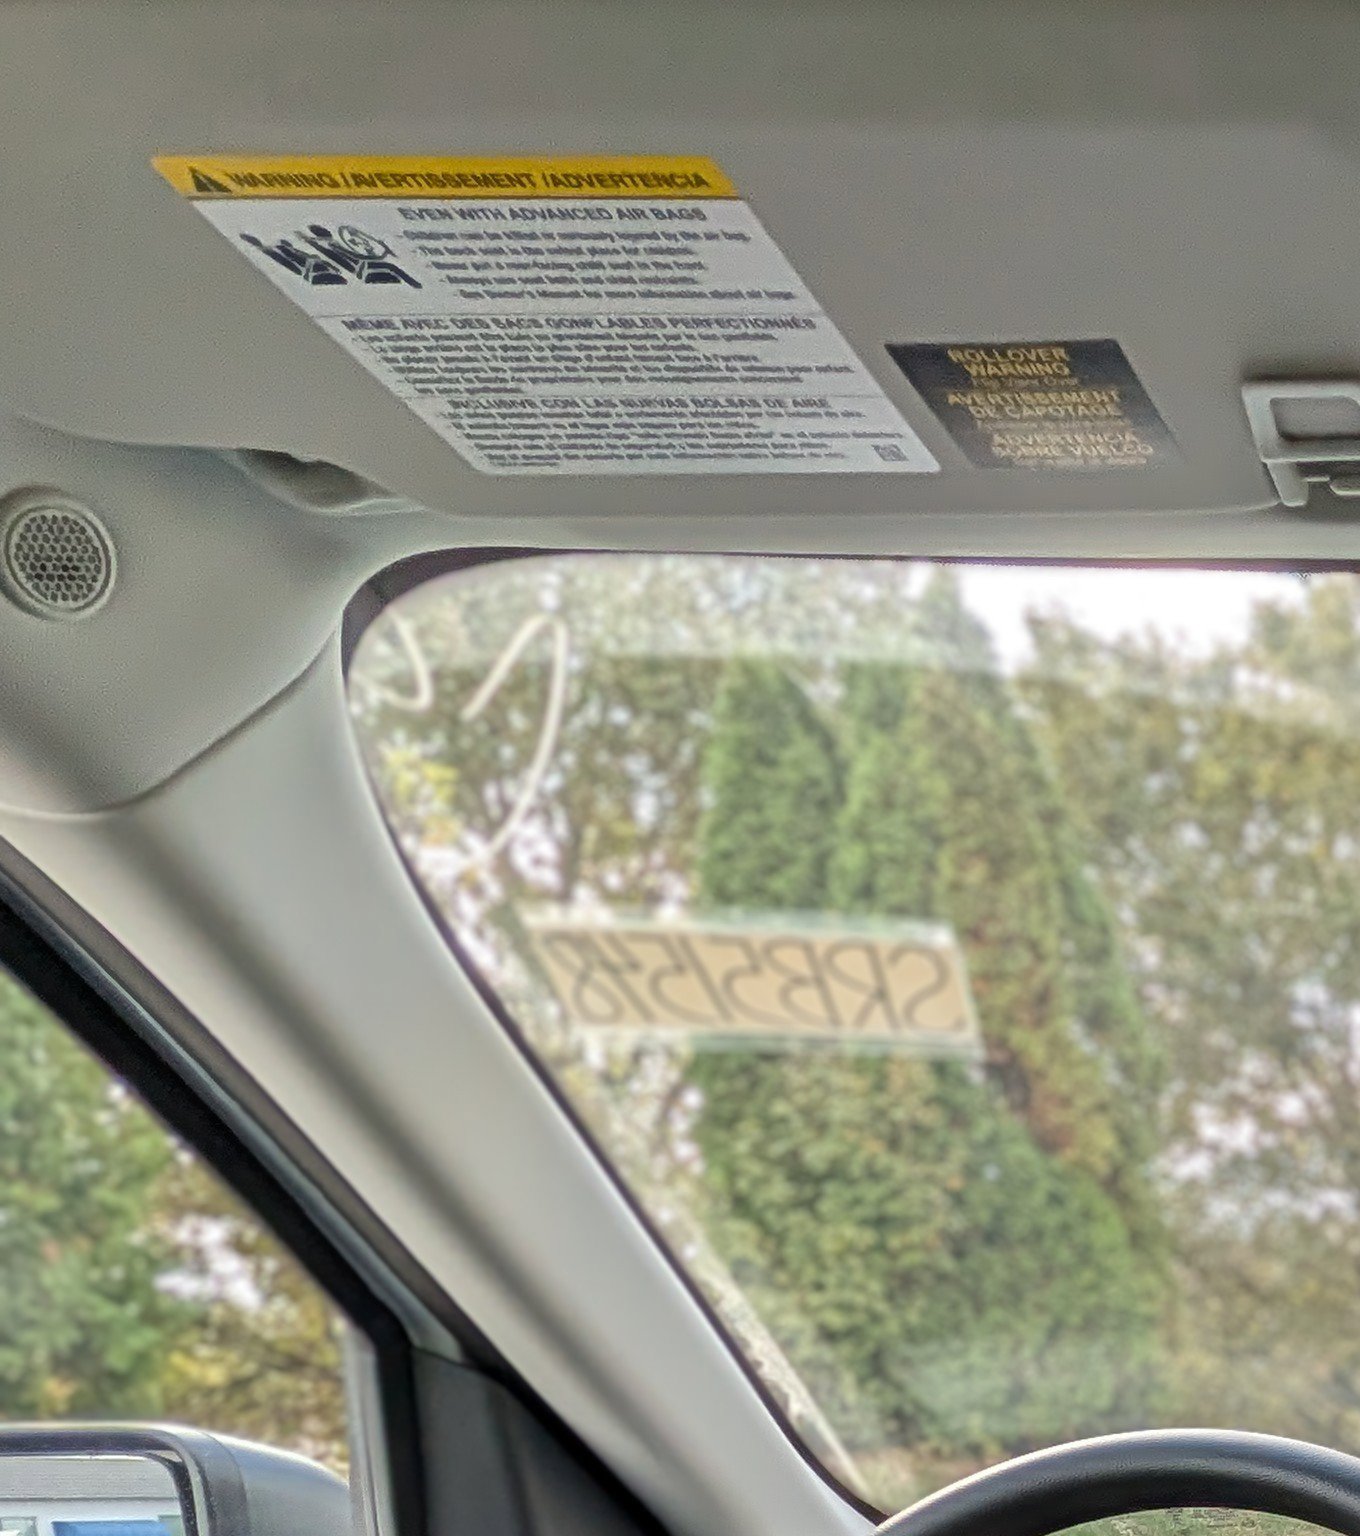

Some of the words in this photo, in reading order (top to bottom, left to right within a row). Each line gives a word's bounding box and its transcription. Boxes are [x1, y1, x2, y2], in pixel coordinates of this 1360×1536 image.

[226, 172, 340, 189] WARNING
[397, 207, 454, 221] EVEN
[455, 207, 507, 221] WITH
[509, 208, 614, 222] ADVANCED
[617, 208, 650, 221] AIR
[948, 348, 1070, 363] ROLLOVER
[963, 363, 1071, 378] WARNING
